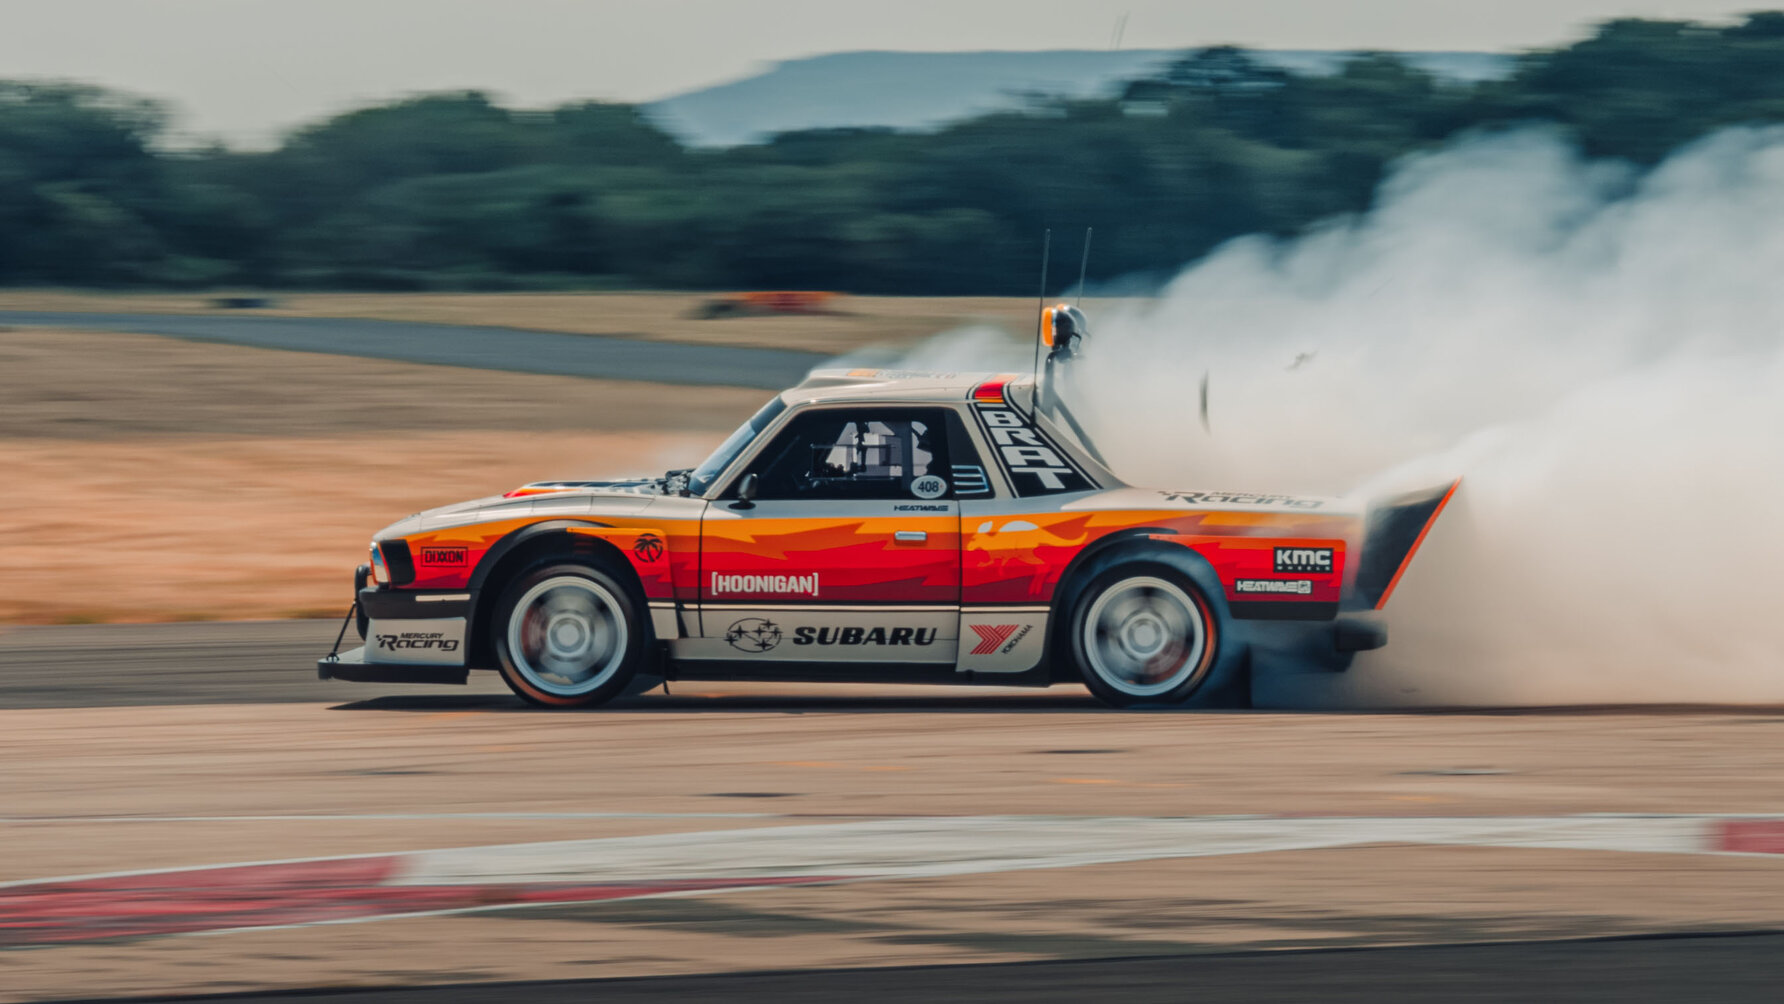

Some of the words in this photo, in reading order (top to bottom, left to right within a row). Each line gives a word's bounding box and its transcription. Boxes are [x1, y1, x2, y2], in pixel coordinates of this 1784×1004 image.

[980, 410, 1073, 489] BRAT
[917, 481, 939, 493] 408
[894, 504, 948, 512] HEATWAVE
[1157, 491, 1325, 509] Racing
[424, 550, 464, 564] DIXXON
[1276, 549, 1331, 566] KMC
[711, 571, 819, 596] [HOONIGAN]
[1236, 581, 1299, 592] HEATWAVE
[376, 634, 459, 652] Racing
[400, 632, 444, 640] MERCURY
[793, 626, 937, 646] SUBARU
[1001, 624, 1034, 655] YOKOHAMA
